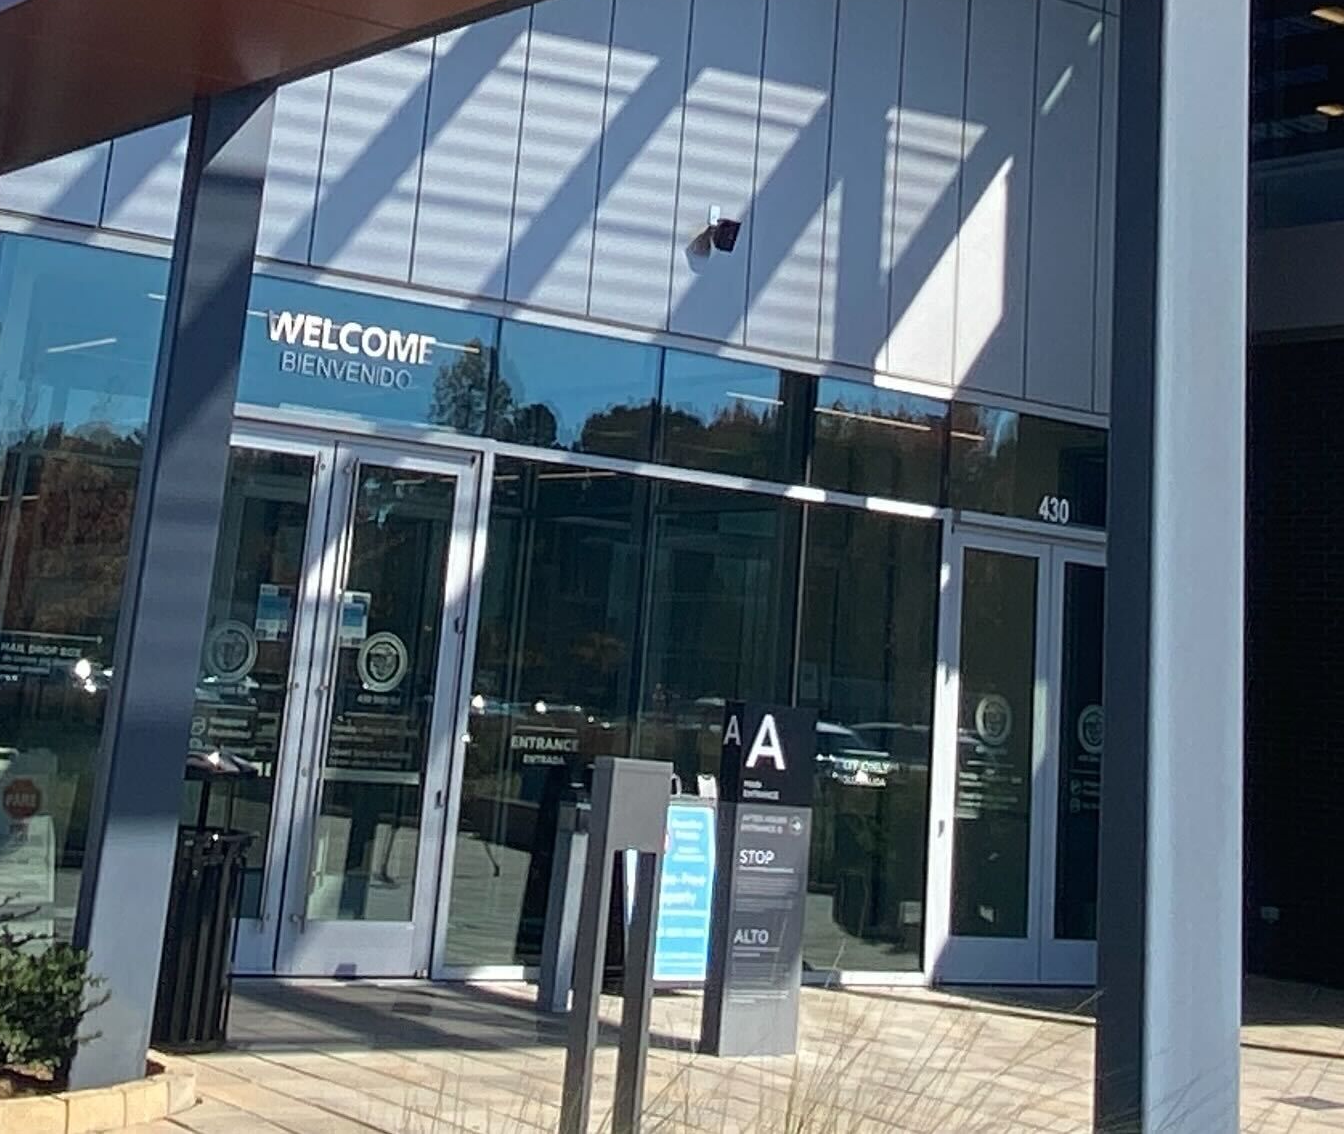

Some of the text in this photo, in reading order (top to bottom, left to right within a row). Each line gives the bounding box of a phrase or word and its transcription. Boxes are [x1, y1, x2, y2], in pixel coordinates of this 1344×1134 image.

[268, 309, 437, 364] WELCOME
[280, 349, 413, 390] BIENVENIDO
[1039, 495, 1070, 524] 430
[510, 734, 580, 752] ENTRANCE
[723, 715, 742, 746] A
[745, 714, 786, 771] A
[739, 849, 776, 865] STOP
[733, 928, 770, 945] ALTO
